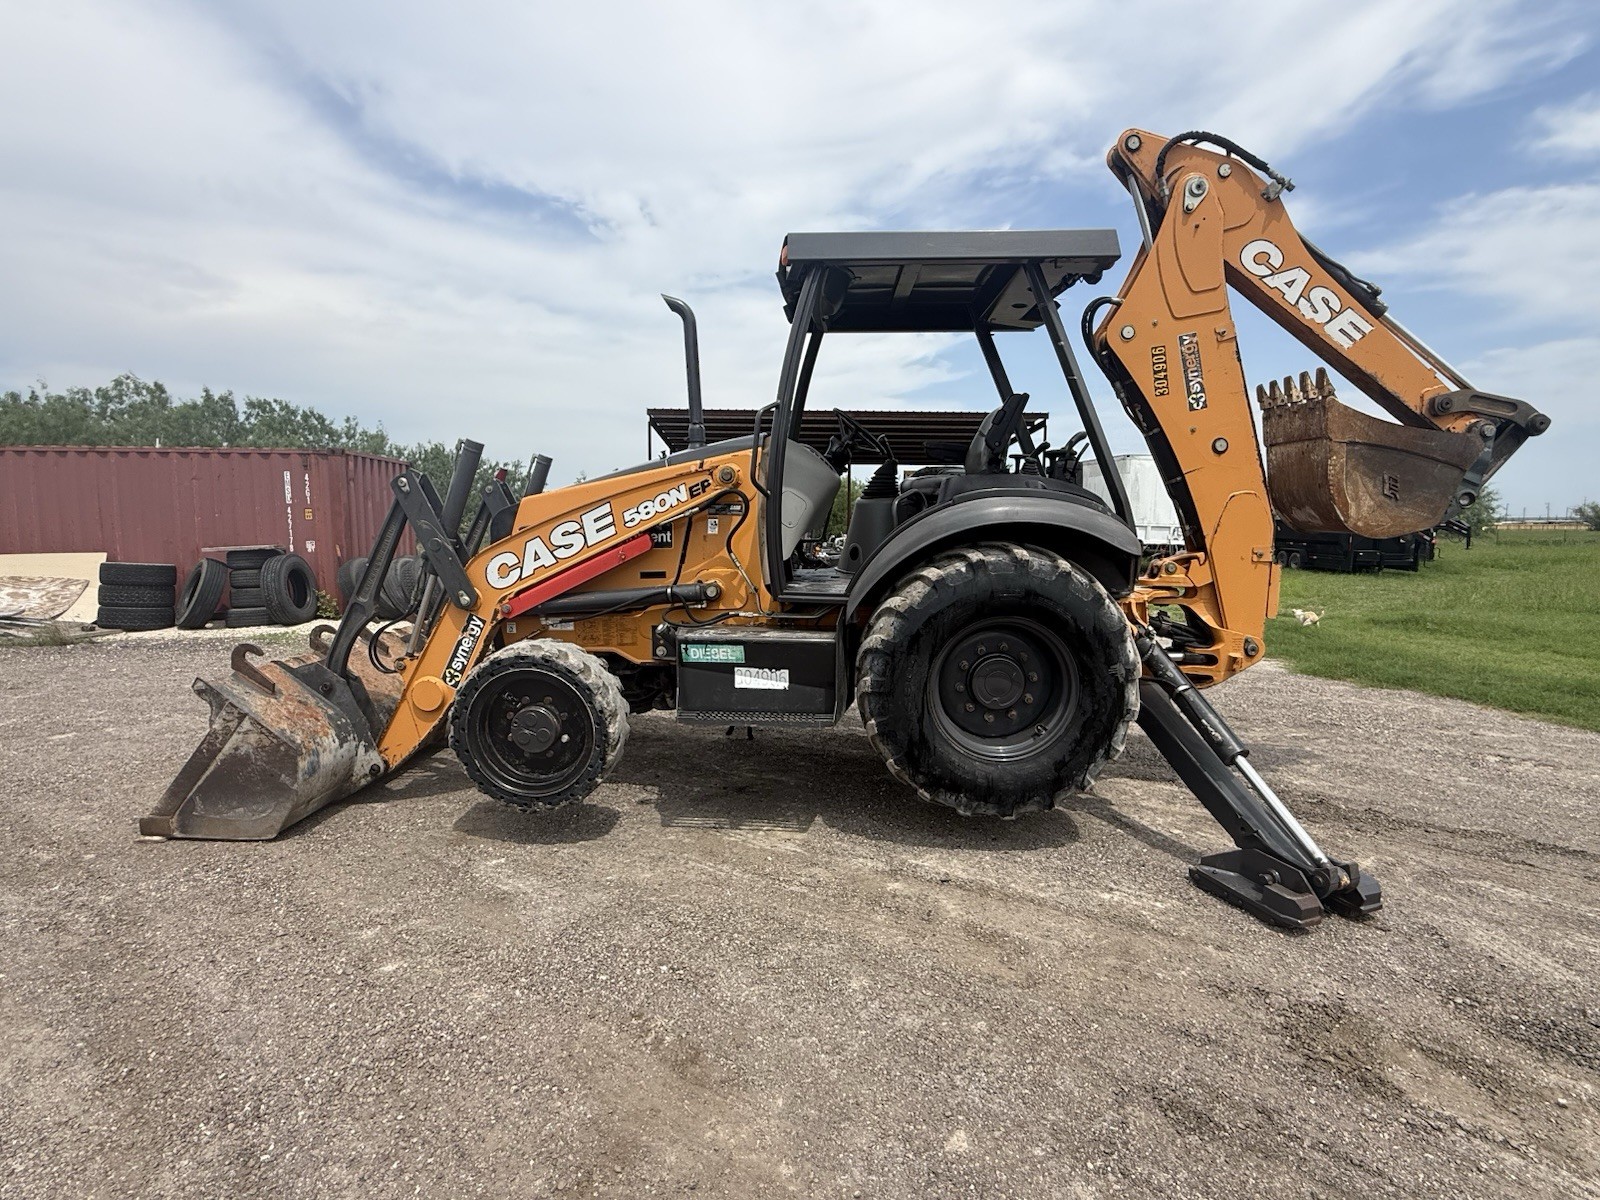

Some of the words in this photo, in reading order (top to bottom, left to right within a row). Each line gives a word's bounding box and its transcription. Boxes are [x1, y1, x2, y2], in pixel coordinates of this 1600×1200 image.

[1240, 239, 1374, 350] CASE
[1152, 347, 1168, 396] 304906
[1182, 336, 1203, 393] synergy
[486, 502, 617, 589] CASE
[623, 483, 688, 528] 580N
[689, 478, 711, 499] EP
[452, 615, 484, 670] synergy
[690, 648, 736, 660] DIESEL
